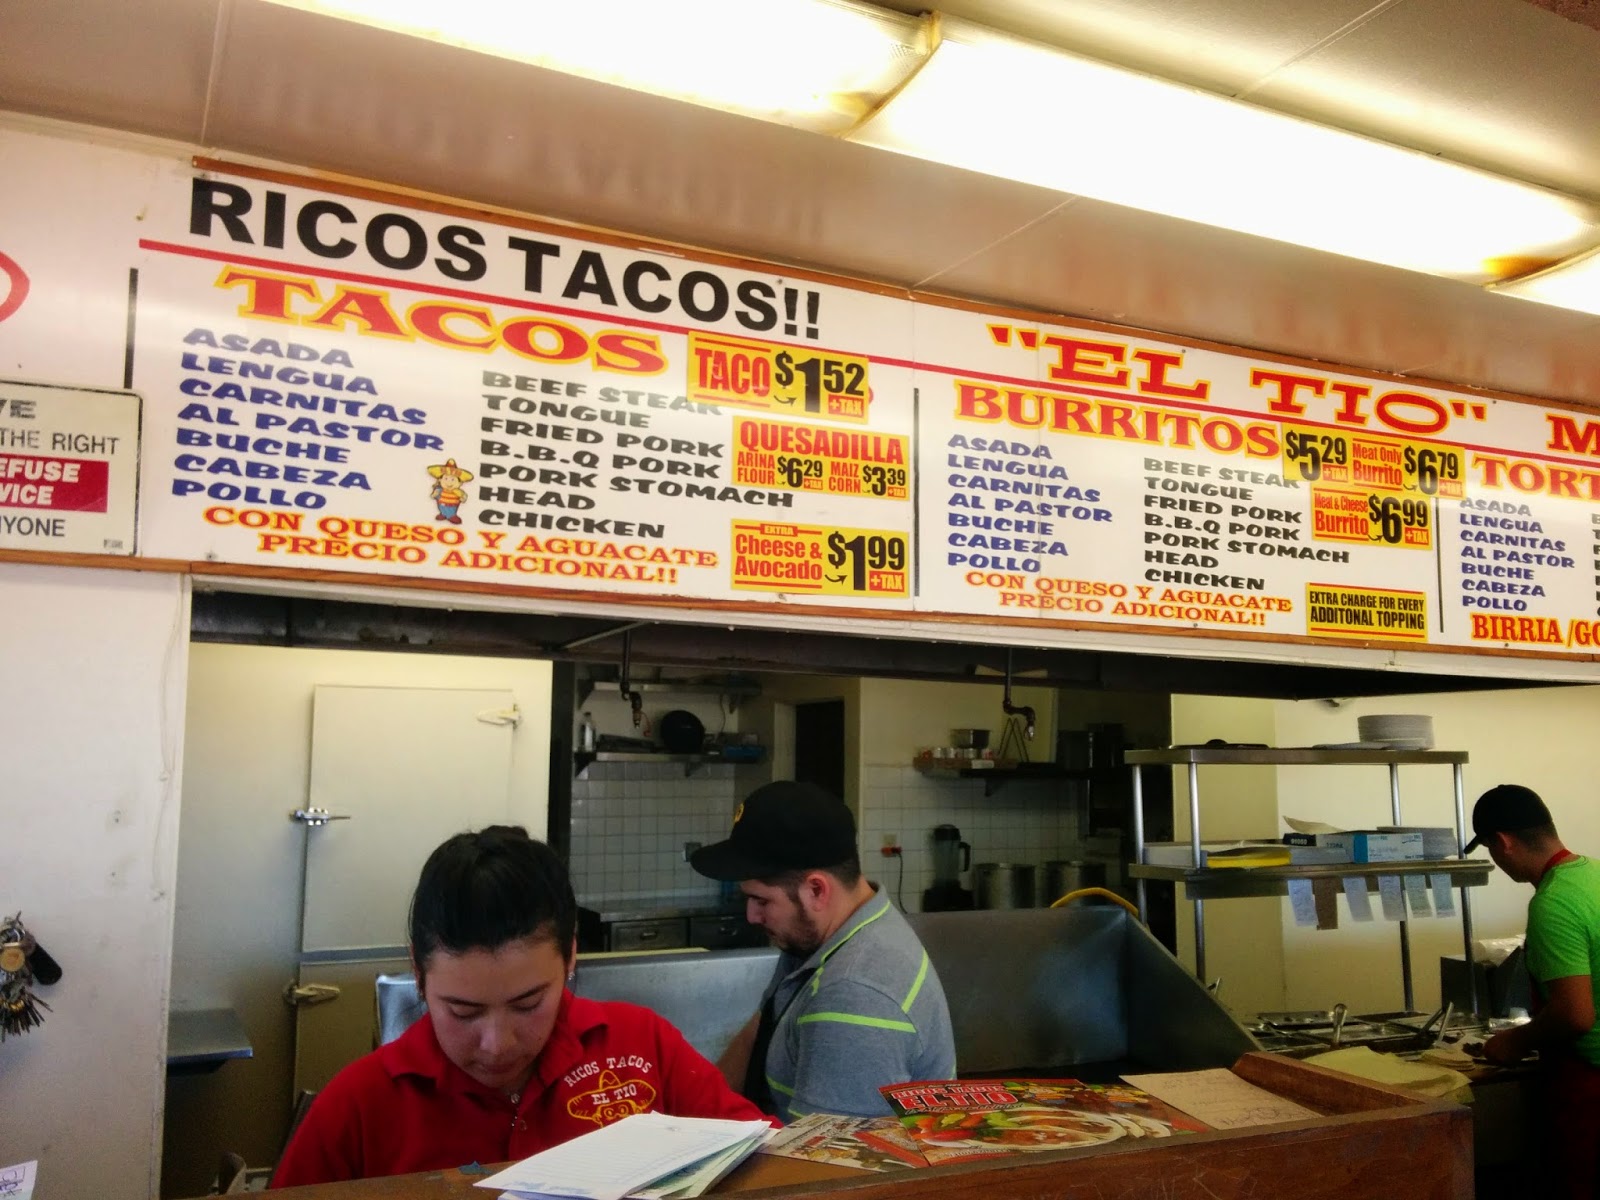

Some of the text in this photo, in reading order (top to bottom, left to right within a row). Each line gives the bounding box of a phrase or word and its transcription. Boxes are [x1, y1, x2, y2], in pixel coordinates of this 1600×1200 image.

[189, 177, 820, 340] RICOS TACOS!!
[214, 264, 669, 377] TACOS
[183, 328, 354, 368] ASADA
[181, 352, 378, 396] LENGUA
[694, 347, 771, 397] TACO
[179, 378, 427, 425] CARNITAS
[482, 369, 723, 416] BEEF STEAK
[482, 394, 652, 429] TONGUE
[953, 379, 1282, 460] BURRITOS
[177, 403, 445, 451] AL PASTOR
[481, 416, 725, 458] FRIED PORK
[52, 432, 120, 455] RIGHT
[176, 427, 351, 463] BUCHE
[740, 421, 904, 465] QUESADILLA
[947, 434, 1053, 460] ASADA
[1353, 443, 1402, 465] Meat Only
[174, 453, 372, 491] CABEZA
[480, 439, 722, 480] B.B.Q PORK
[738, 451, 775, 469] ARINA
[831, 461, 859, 478] MAIZ
[947, 453, 1069, 480] LENGUA
[1144, 457, 1300, 489] BEEF STEAK
[1353, 460, 1403, 486] Burrito
[479, 462, 794, 508] PORK STOMACH
[738, 467, 775, 485] FLOUR
[829, 476, 861, 494] CORN
[947, 474, 1101, 502] CARNITAS
[1144, 476, 1254, 501] TONGUE
[172, 478, 327, 510] POLLO
[478, 485, 596, 511] HEAD
[947, 493, 1113, 522] AL PASTOR
[1314, 493, 1368, 513] Meat & Cheese
[1459, 497, 1532, 517] ASADA
[1144, 495, 1302, 524] FRIED PORK
[1315, 510, 1369, 535] Burrito
[1460, 512, 1544, 534] LENGUA
[203, 505, 719, 568] CON QUESO Y AGUACATE
[478, 509, 665, 540] CHICKEN
[764, 525, 795, 536] EXTRA
[947, 512, 1054, 536] BUCHE
[1144, 513, 1300, 541] B.B.Q PORK
[735, 534, 823, 559] Cheese &
[947, 532, 1069, 557] CABEZA
[1144, 531, 1350, 564] PORK STOMACH
[1460, 530, 1566, 552] CARNITAS
[257, 532, 678, 584] PRECIO ADICIONAL!!
[735, 555, 823, 581] Avocado
[947, 552, 1041, 573] POLLO
[1144, 550, 1219, 568] HEAD
[1461, 545, 1487, 560] AL
[1493, 548, 1575, 569] PASTOR
[1145, 568, 1265, 591] CHICKEN
[1461, 562, 1535, 581] BUCHE
[964, 571, 1293, 613] CON QUESO Y AGUACATE
[1309, 591, 1424, 612] EXTRA CHARGE FOR EVERY
[1462, 579, 1546, 598] CABEZA
[999, 592, 1266, 626] PRECIO ADICIONAL!!
[1462, 595, 1528, 612] POLLO
[1310, 606, 1425, 630] ADDITONAL TOPPING
[1470, 612, 1564, 645] BIRRIA
[563, 1055, 653, 1088] RICOS TACOS
[591, 1084, 638, 1105] EL TIO
